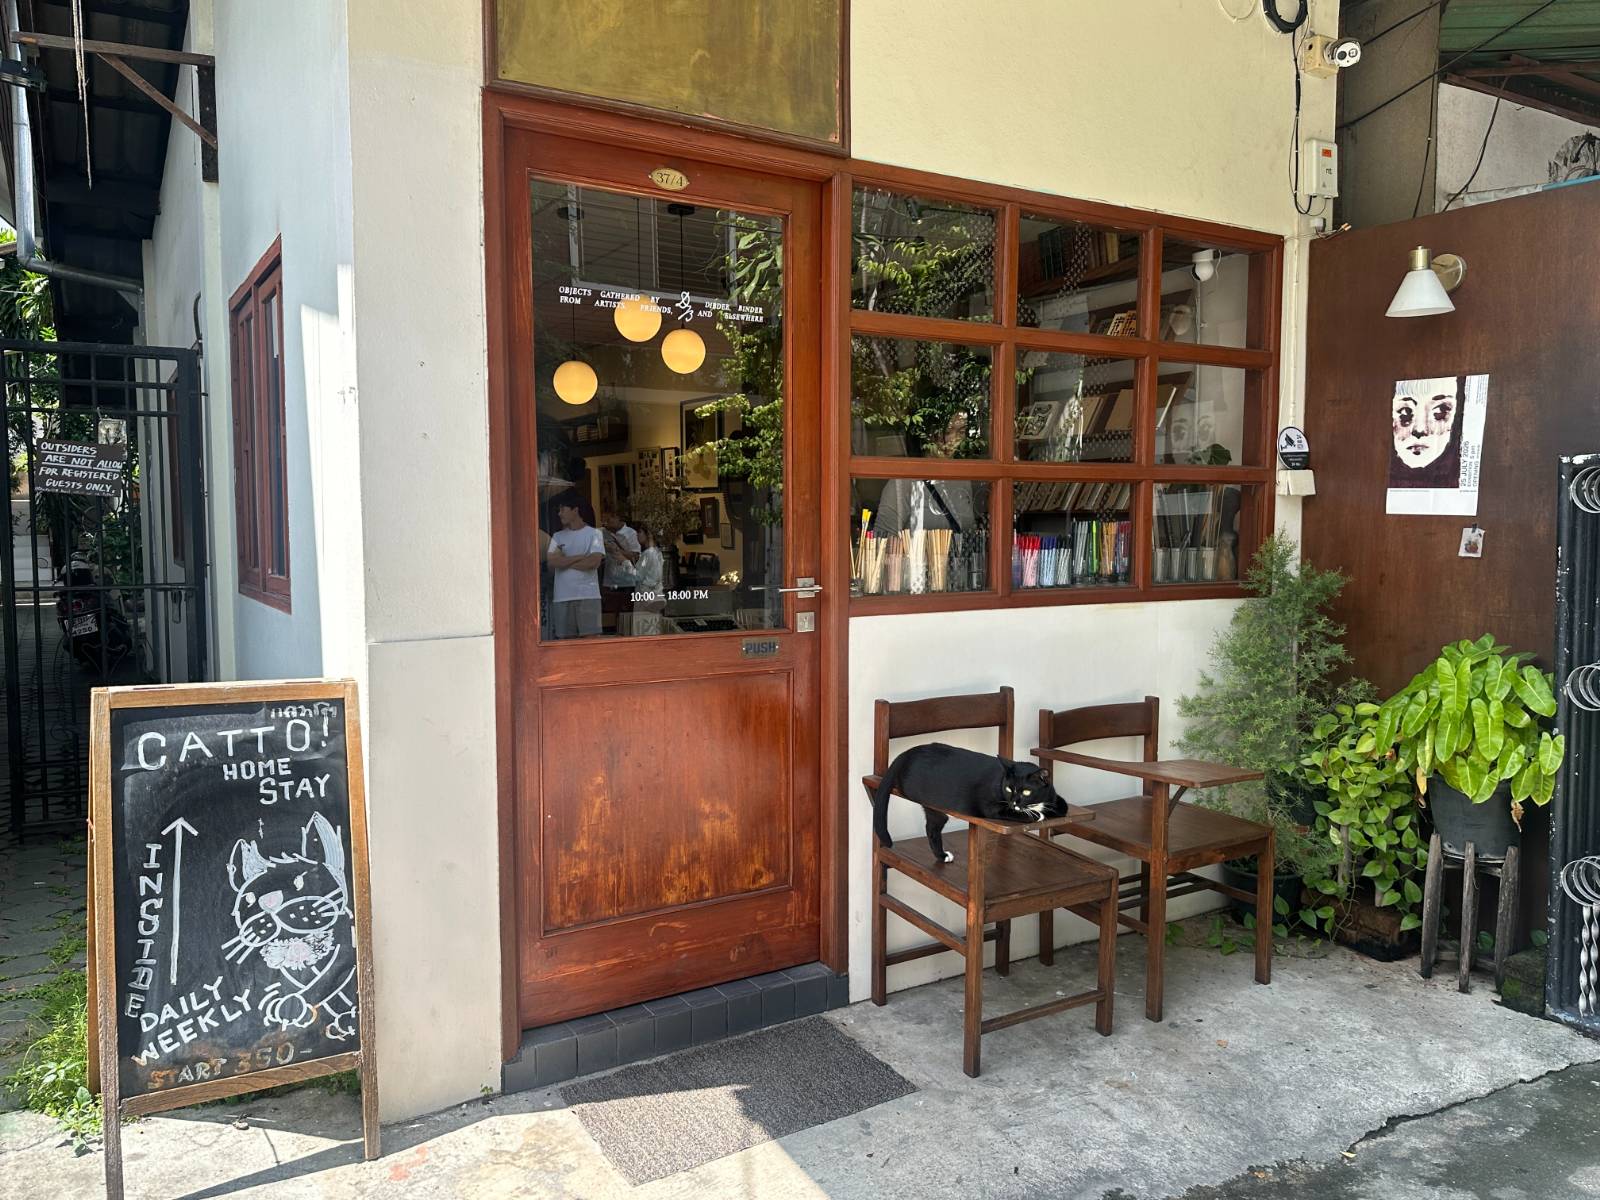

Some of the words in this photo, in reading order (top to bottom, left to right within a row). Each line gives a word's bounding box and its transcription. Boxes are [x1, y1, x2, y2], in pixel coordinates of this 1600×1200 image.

[656, 172, 683, 187] 37/4
[558, 286, 592, 297] OBJECTS
[600, 290, 640, 302] GATHERED
[650, 296, 660, 304] BY
[738, 304, 763, 314] BINDER
[559, 296, 581, 305] FROM
[697, 309, 713, 318] AND
[724, 312, 764, 323] ELSEWHERE
[40, 441, 97, 456] OUTSIDERS
[45, 454, 66, 464] ARE
[71, 457, 94, 467] NOT
[39, 466, 58, 476] FOR
[62, 468, 119, 480] REGISTERED
[46, 478, 83, 490] GUESTS
[630, 591, 655, 602] 10:00
[668, 590, 691, 600] 18:00
[693, 589, 709, 600] PM
[745, 641, 776, 655] PUSH
[137, 714, 330, 771] CATTO!
[222, 757, 292, 781] HOME
[259, 773, 331, 805] STAY
[124, 843, 163, 1018] INSIDE
[139, 975, 224, 1033] DAILY
[131, 988, 252, 1067] WEEKLY
[147, 1057, 228, 1090] START
